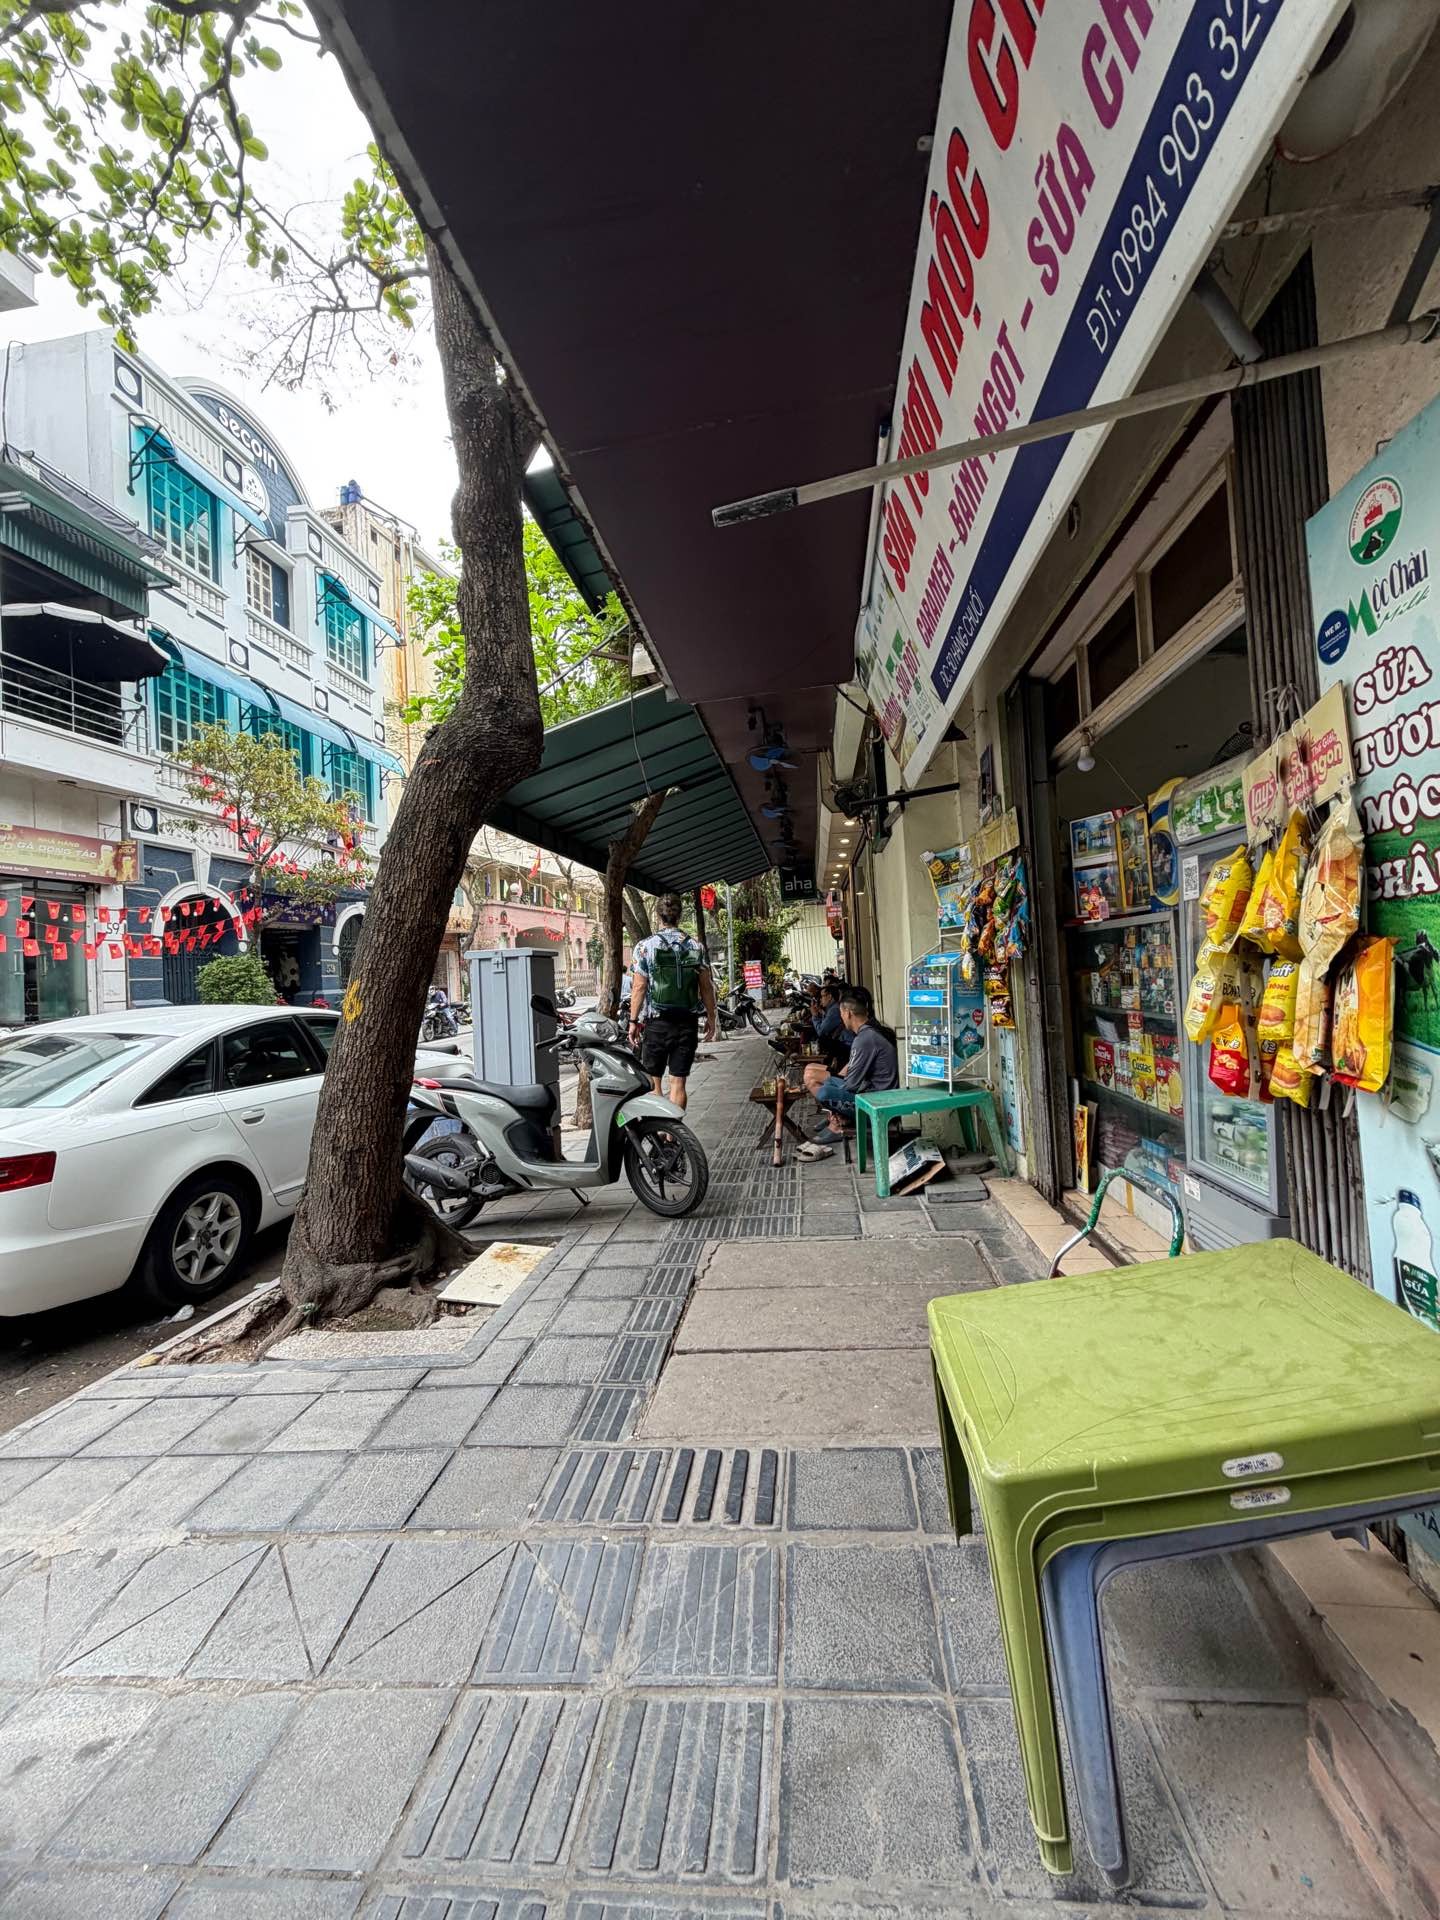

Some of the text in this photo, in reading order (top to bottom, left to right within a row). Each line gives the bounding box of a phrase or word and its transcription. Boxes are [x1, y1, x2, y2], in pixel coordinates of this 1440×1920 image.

[1086, 0, 1271, 354] ĐT: 0984 903 32
[920, 127, 990, 398] MỘC
[916, 542, 955, 649] CARAMEN
[974, 320, 1025, 464] NGỌT
[1027, 122, 1097, 296] SỮA
[218, 406, 278, 475] secoin
[1354, 646, 1432, 715] SỮA
[1363, 773, 1440, 835] MỘC
[784, 875, 813, 892] aha
[1367, 841, 1440, 899] CHÂ
[107, 922, 120, 935] 59
[1131, 1059, 1152, 1074] Custas
